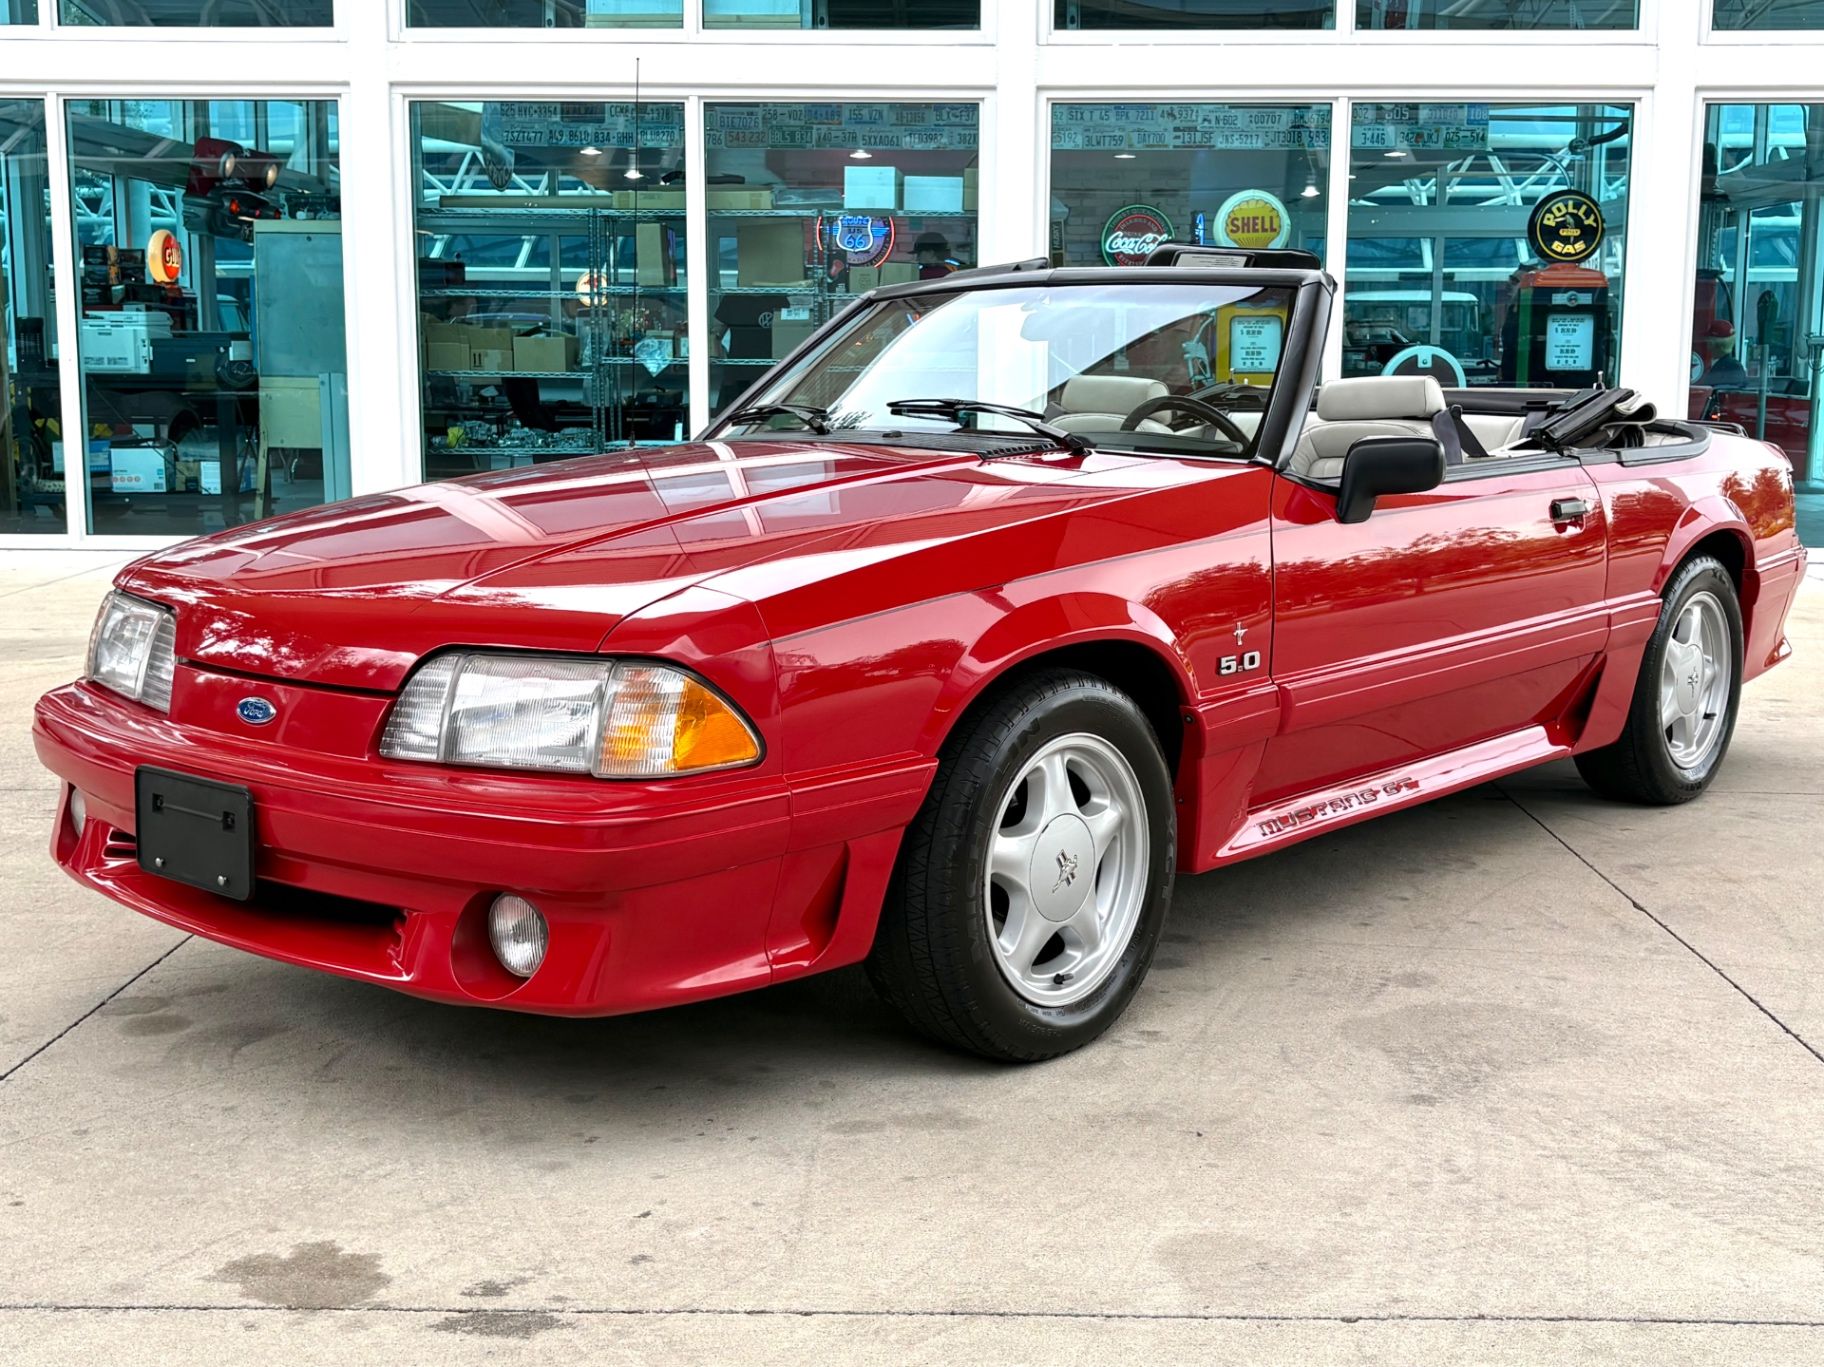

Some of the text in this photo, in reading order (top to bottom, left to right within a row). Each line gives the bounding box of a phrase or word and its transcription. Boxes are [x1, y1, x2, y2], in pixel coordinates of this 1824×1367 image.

[1230, 215, 1277, 234] SHELL
[1543, 200, 1597, 227] POLLY
[844, 234, 865, 248] 66
[1551, 240, 1587, 255] GAS
[1217, 650, 1261, 675] 5.0
[1256, 788, 1380, 837] MUSTANG
